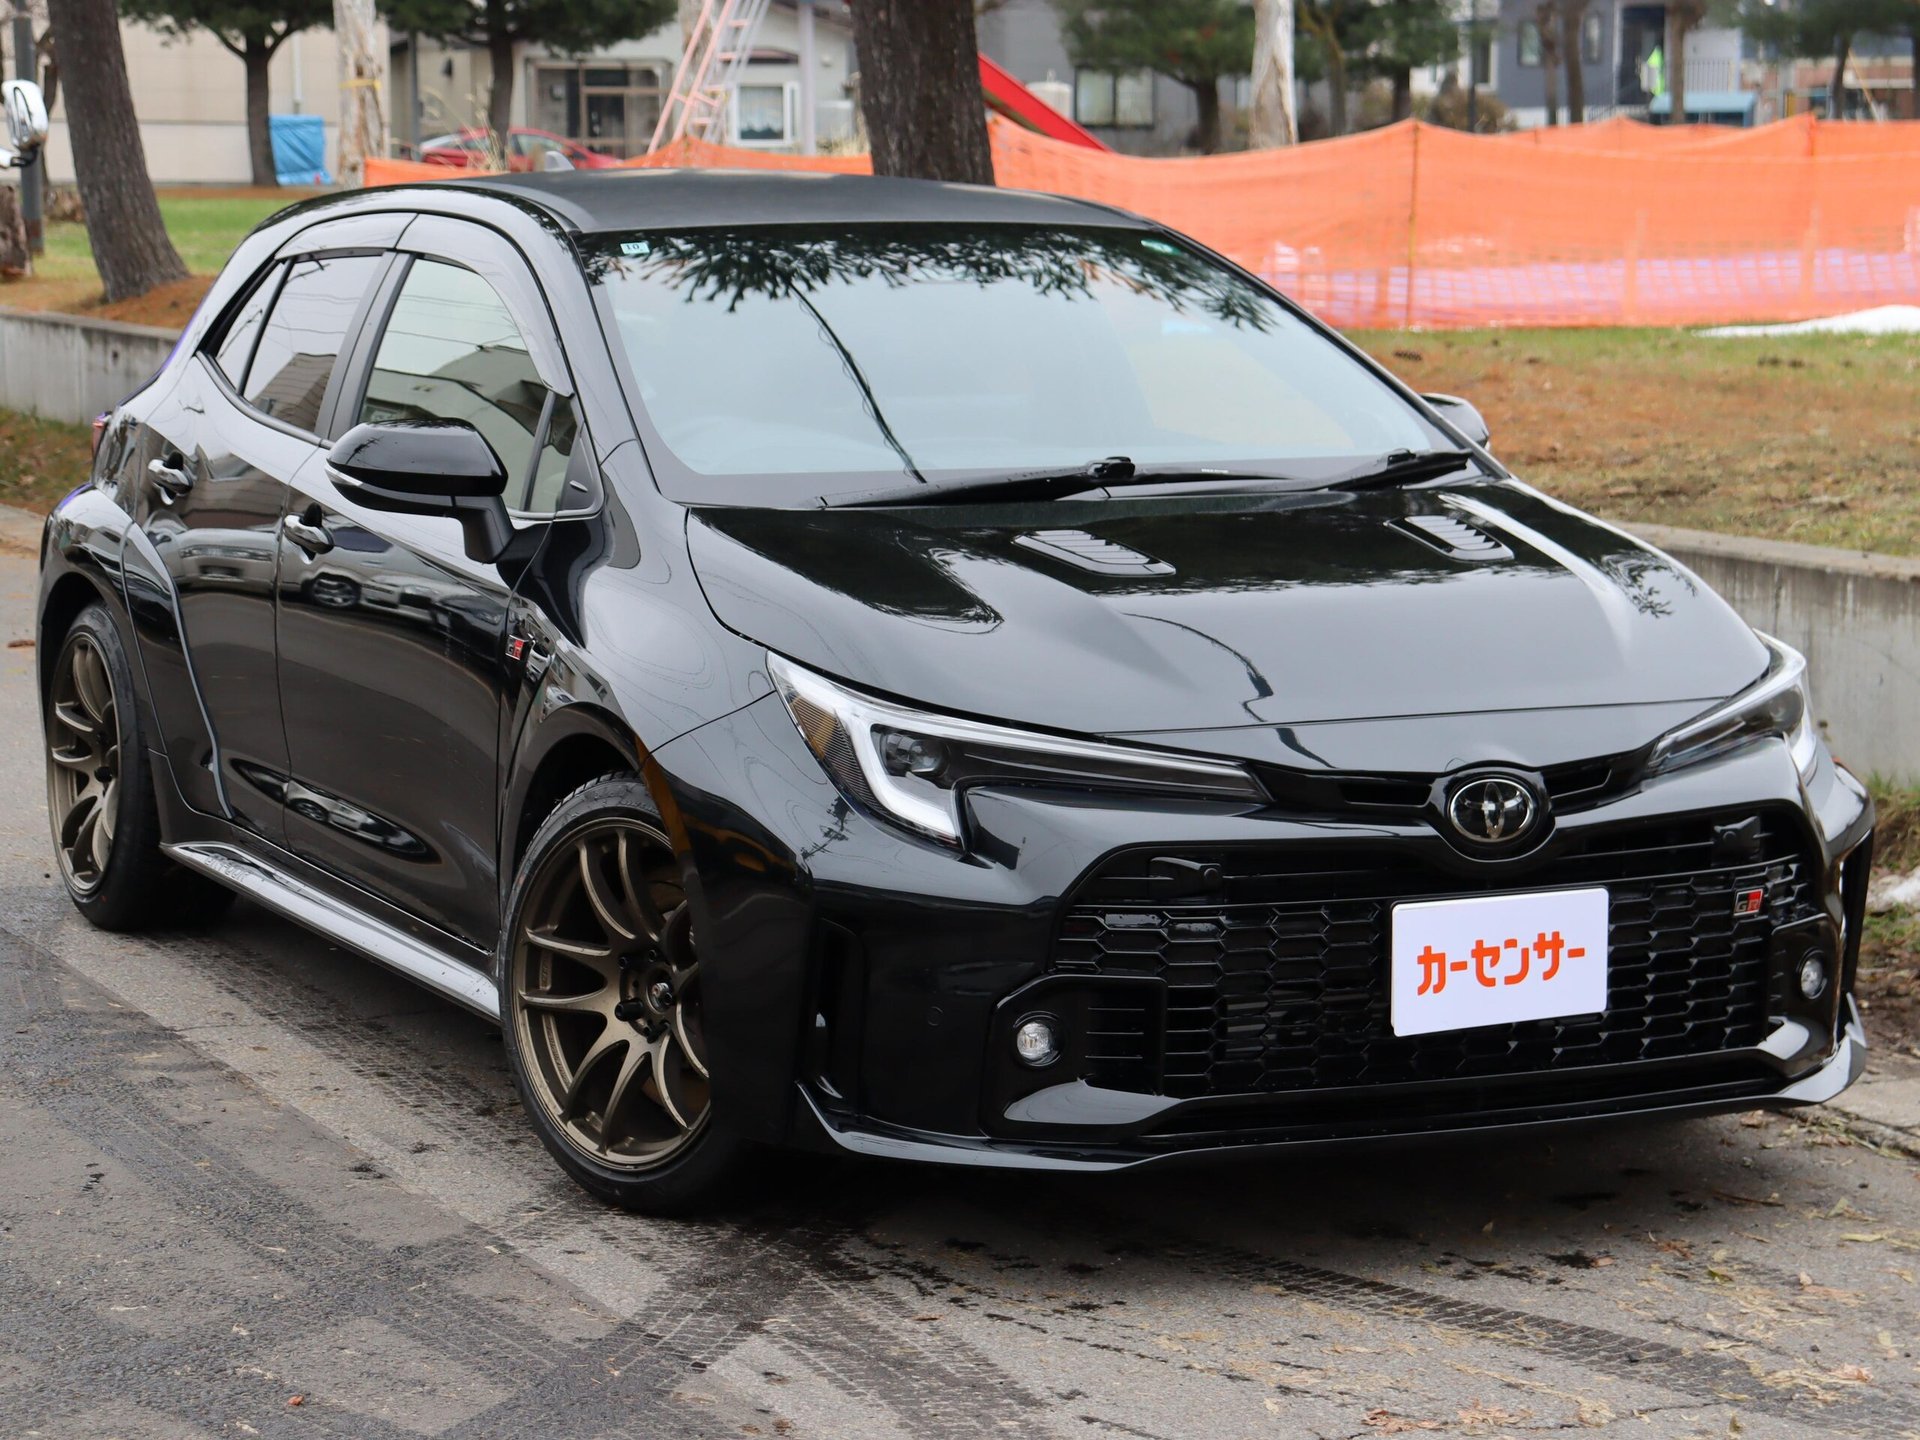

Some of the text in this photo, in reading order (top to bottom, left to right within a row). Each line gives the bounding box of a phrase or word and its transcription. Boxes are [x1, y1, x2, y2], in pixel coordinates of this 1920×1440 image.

[1417, 931, 1585, 996] カーセンサー
